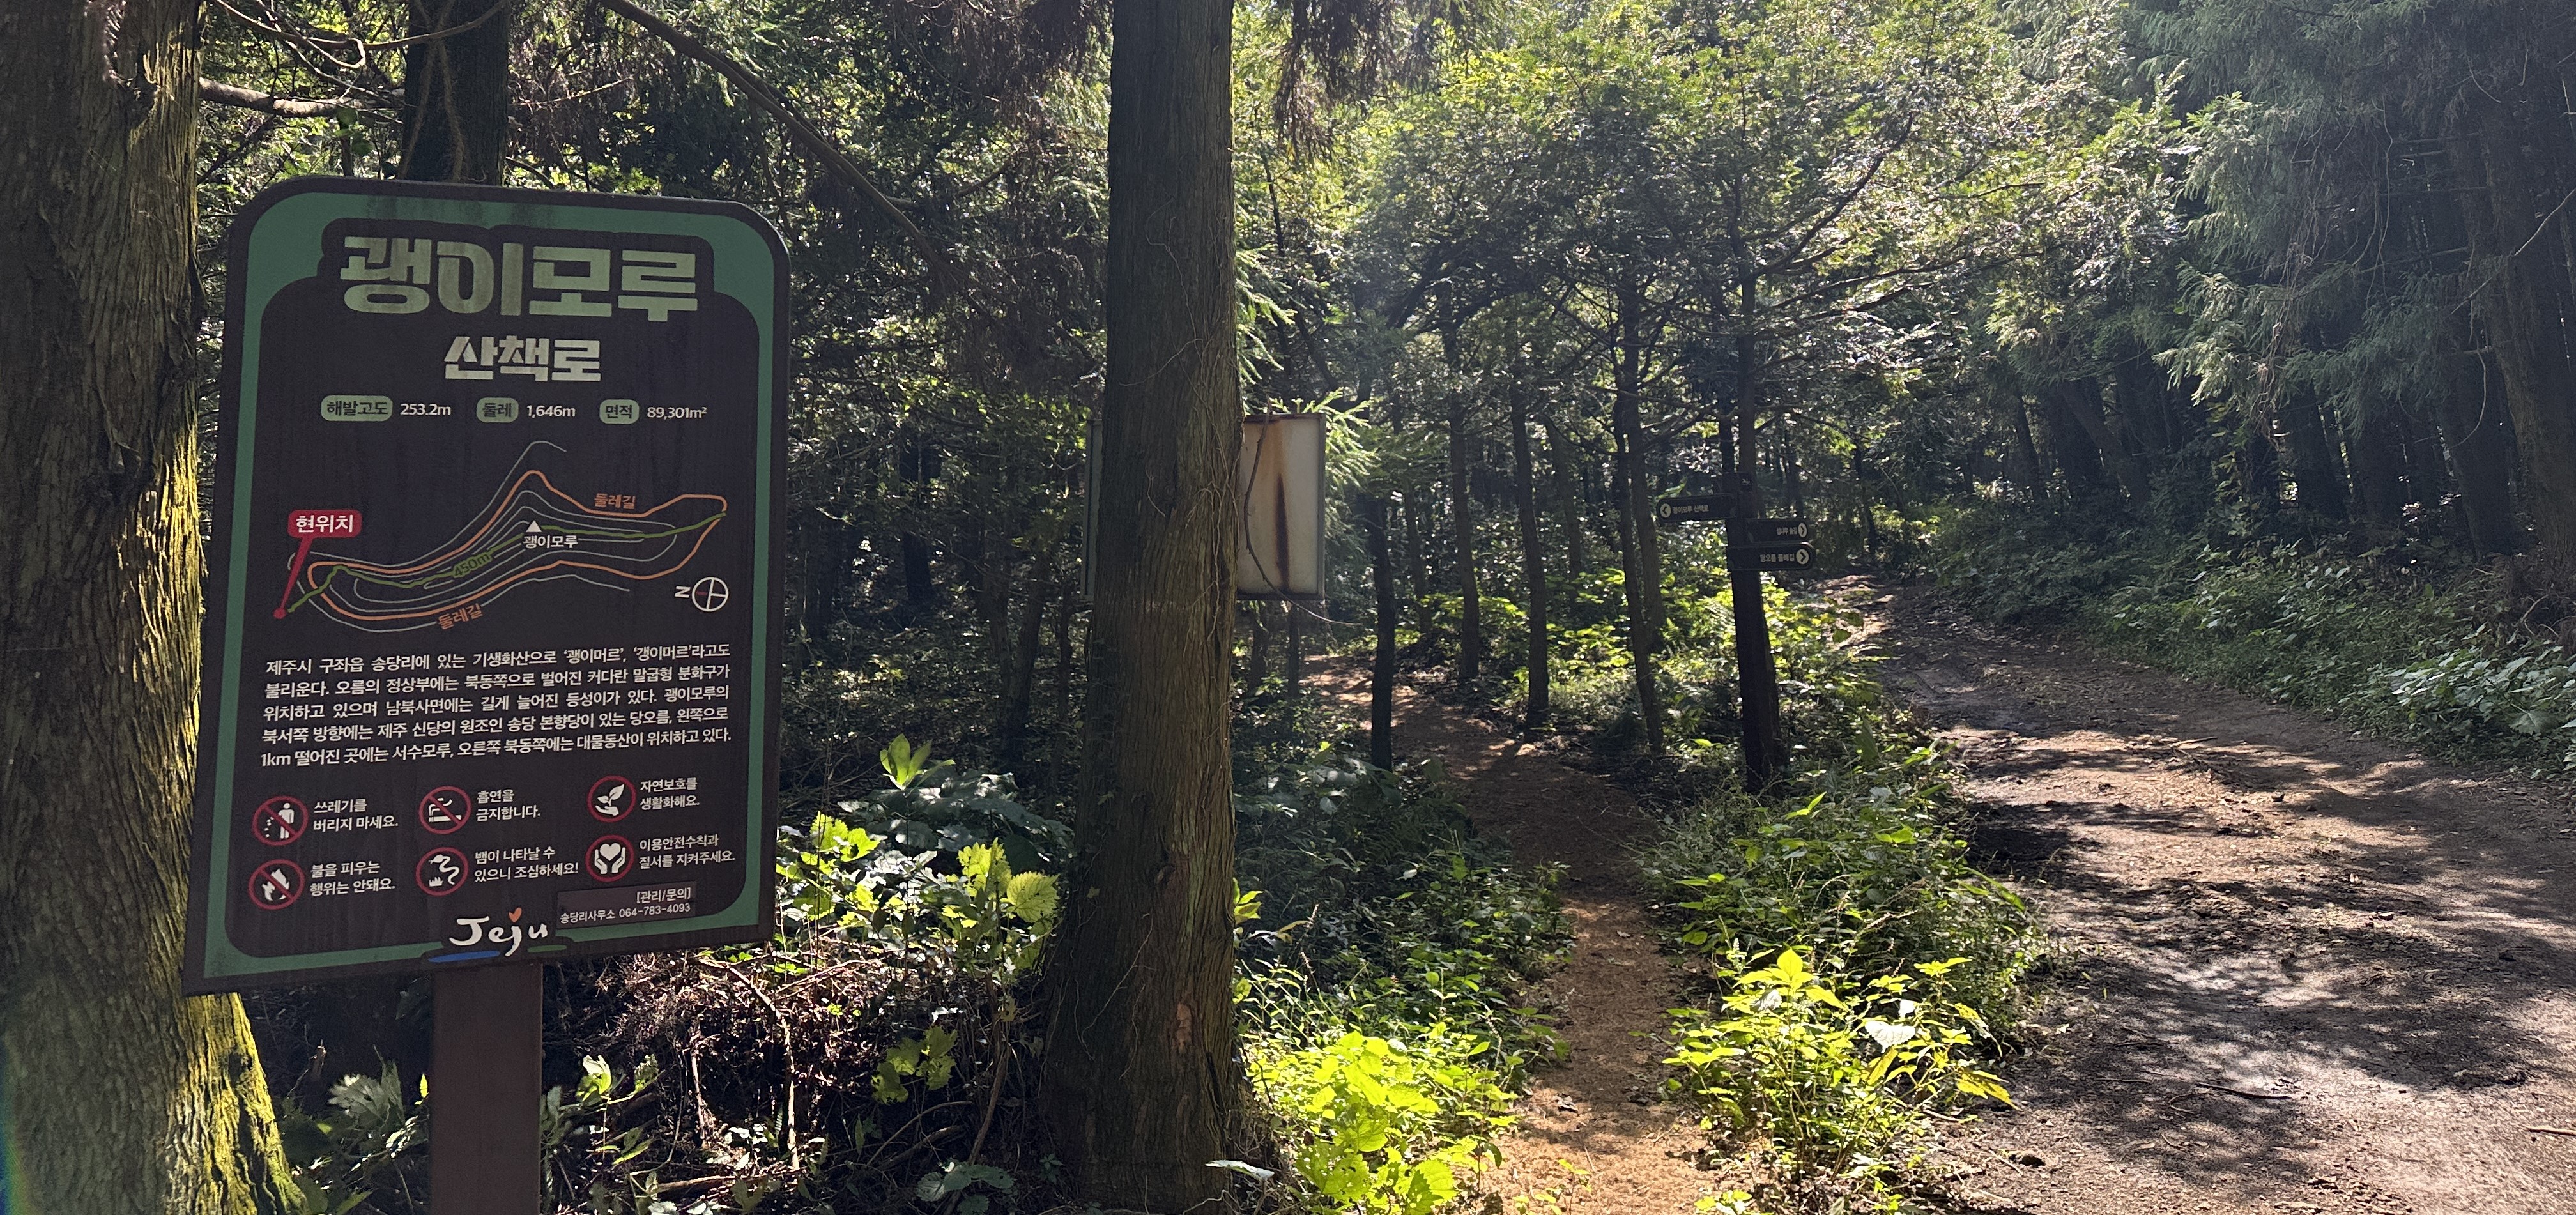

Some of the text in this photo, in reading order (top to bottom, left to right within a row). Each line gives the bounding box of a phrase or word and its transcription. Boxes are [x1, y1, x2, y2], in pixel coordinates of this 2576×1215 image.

[340, 236, 698, 322] 괭이모루
[444, 334, 601, 381] 산책로
[326, 401, 388, 416] 해발고도
[400, 403, 451, 416] 253.2m
[483, 403, 511, 418] 둘레
[526, 405, 576, 417] 1,646m
[605, 404, 633, 419] 면적
[594, 493, 636, 508] 둘레길
[296, 514, 354, 533] 현위치
[523, 535, 578, 549] 괭이모루
[454, 554, 490, 576] 450m
[438, 603, 483, 630] 둘레길
[267, 659, 312, 675] 제주시
[320, 657, 364, 673] 구좌읍
[371, 655, 429, 671] 송당리에
[438, 653, 466, 669] 있는
[473, 650, 556, 667] 기생화산으로
[264, 664, 730, 698] 불리운다. 오름의 정상부에는 북동쪽으로 벌어진 커다란 말굽형 분화구가
[263, 685, 730, 721] 위치하고 있으며 남북사면에는 길게 늘어진 등성이가 있다. 괭이모루의
[263, 707, 729, 744] 북서쪽 방향에는 제주 신당의 원조인 송당 본향당이 있는 당오름, 왼쪽으로
[261, 727, 731, 767] 1km 떨어진 곳에는 서수모루, 오른쪽 북동쪽에는 대물동산이 위치하고 있다.
[641, 777, 697, 792] 자연보호를
[477, 789, 514, 804] 흡연을
[640, 795, 700, 810] 생활화해요.
[314, 799, 367, 814] 쓰레기를
[477, 806, 540, 821] 금지합니다.
[313, 815, 398, 832] 버리지 마세요.
[640, 834, 719, 852] 이용안전수칙과
[475, 846, 555, 864] 뱀이 나타날 수
[639, 850, 735, 870] 질서를 지켜주세요.
[310, 861, 380, 878] 불을 피우는
[475, 863, 578, 883] 있으니 조심하세요!
[310, 878, 395, 897] 행위는 안돼요.
[636, 887, 691, 903] [관리/문의]
[560, 903, 691, 924] 송당리사무소 064-783-4093
[449, 907, 548, 956] Jeju
